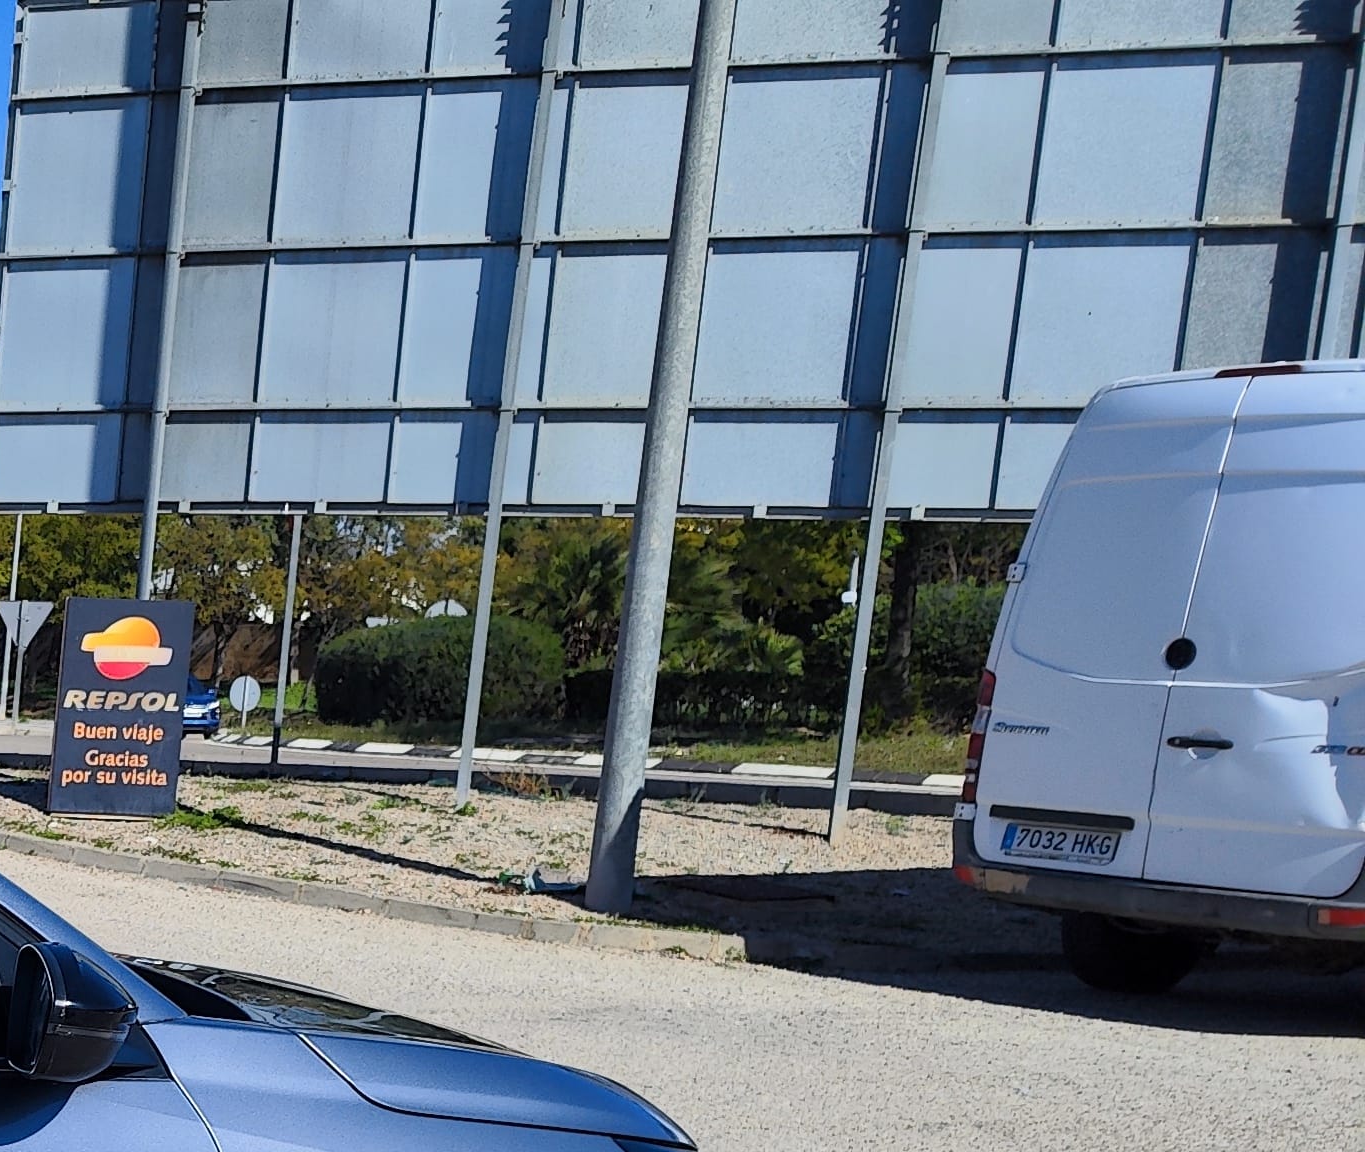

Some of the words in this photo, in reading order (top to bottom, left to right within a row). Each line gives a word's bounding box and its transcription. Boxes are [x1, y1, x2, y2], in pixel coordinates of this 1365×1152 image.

[62, 689, 180, 712] REPSOL
[73, 722, 117, 739] Buen
[122, 723, 164, 745] viaje
[84, 749, 148, 768] Gracias
[61, 769, 91, 786] por
[96, 771, 116, 784] su
[121, 768, 168, 786] visita
[1016, 828, 1067, 851] 7032
[1071, 833, 1112, 855] HKG
